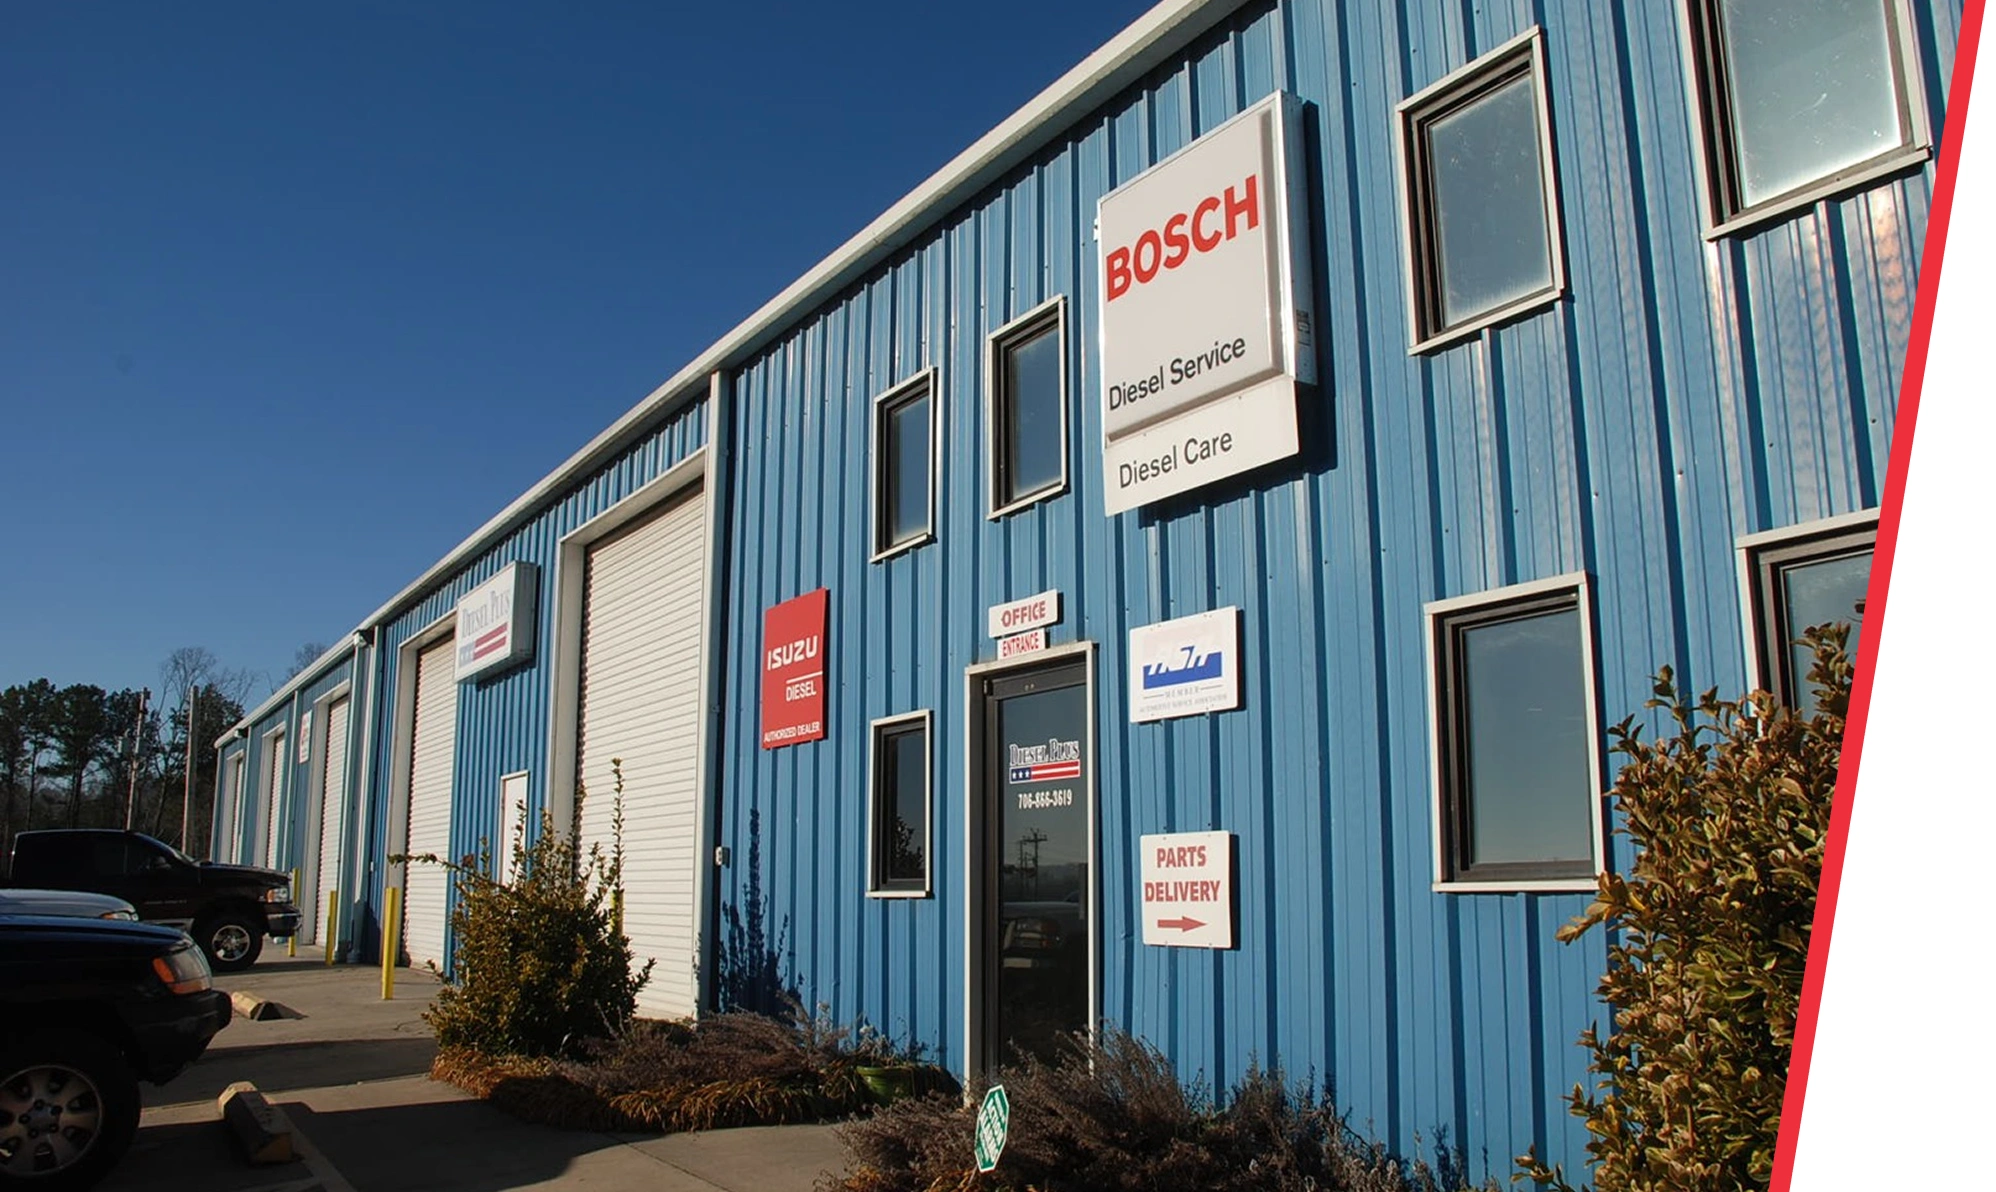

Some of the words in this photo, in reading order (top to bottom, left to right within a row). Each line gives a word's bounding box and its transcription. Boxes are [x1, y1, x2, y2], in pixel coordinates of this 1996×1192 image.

[1106, 174, 1260, 302] BOSCH
[1109, 366, 1164, 411] Diesel
[1170, 337, 1246, 385] Service
[1120, 445, 1178, 489] Diesel
[1184, 431, 1233, 468] Care
[1002, 601, 1046, 628] OFFICE
[767, 635, 818, 671] ISUZU
[1003, 631, 1039, 657] ENTRANCE
[786, 680, 817, 702] DIESEL
[763, 726, 796, 742] AUTHORIZED
[798, 721, 820, 736] DEALER
[1009, 744, 1048, 766] DIESEL
[1049, 739, 1080, 761] PLUS
[1157, 846, 1206, 868] PARTS
[1145, 881, 1221, 902] DELIVERY
